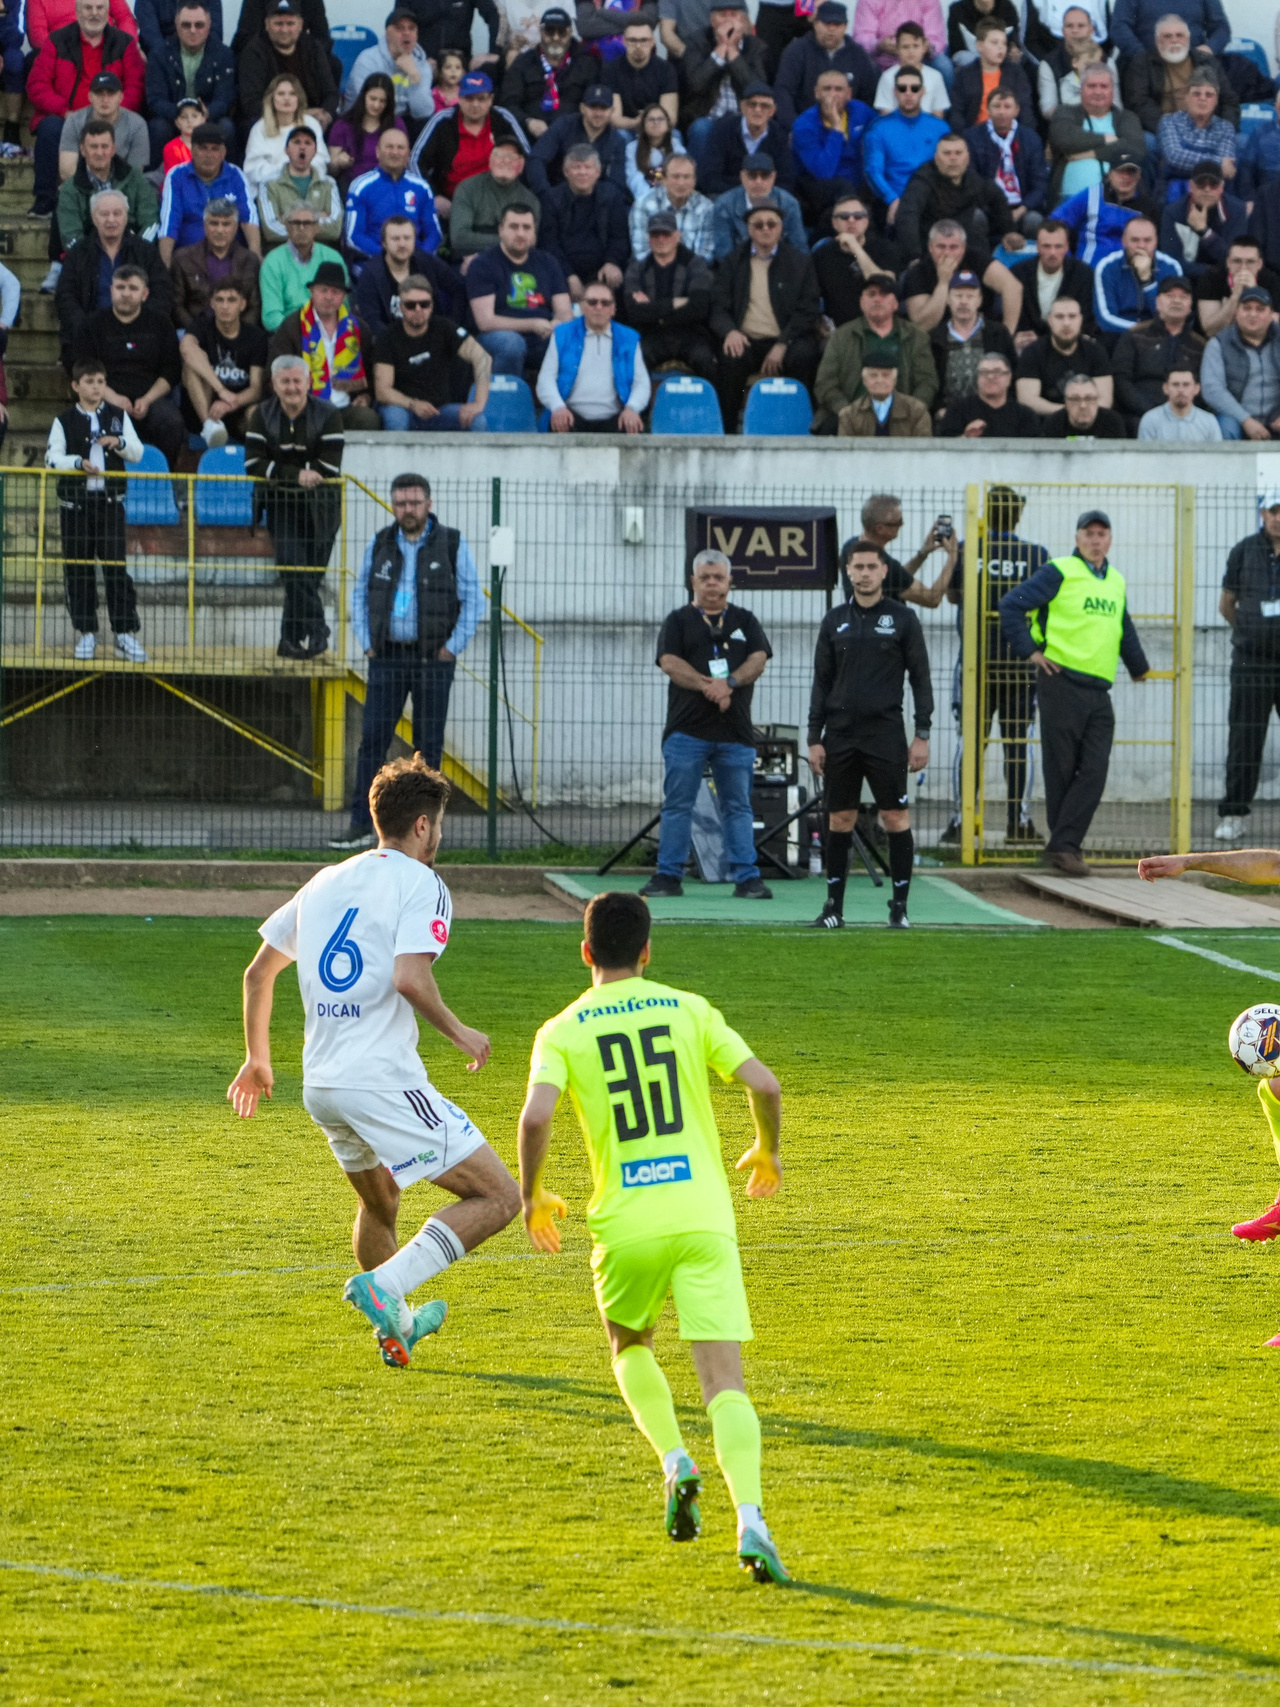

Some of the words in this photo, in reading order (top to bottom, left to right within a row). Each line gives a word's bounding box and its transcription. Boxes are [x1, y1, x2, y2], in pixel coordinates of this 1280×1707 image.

[713, 526, 808, 557] VAR
[318, 907, 364, 993] 6
[317, 1003, 360, 1018] DICAN
[577, 997, 679, 1023] Panifcom
[596, 1025, 684, 1142] 35
[391, 1157, 418, 1173] Smart
[418, 1150, 435, 1162] Eco
[424, 1156, 438, 1166] Plus
